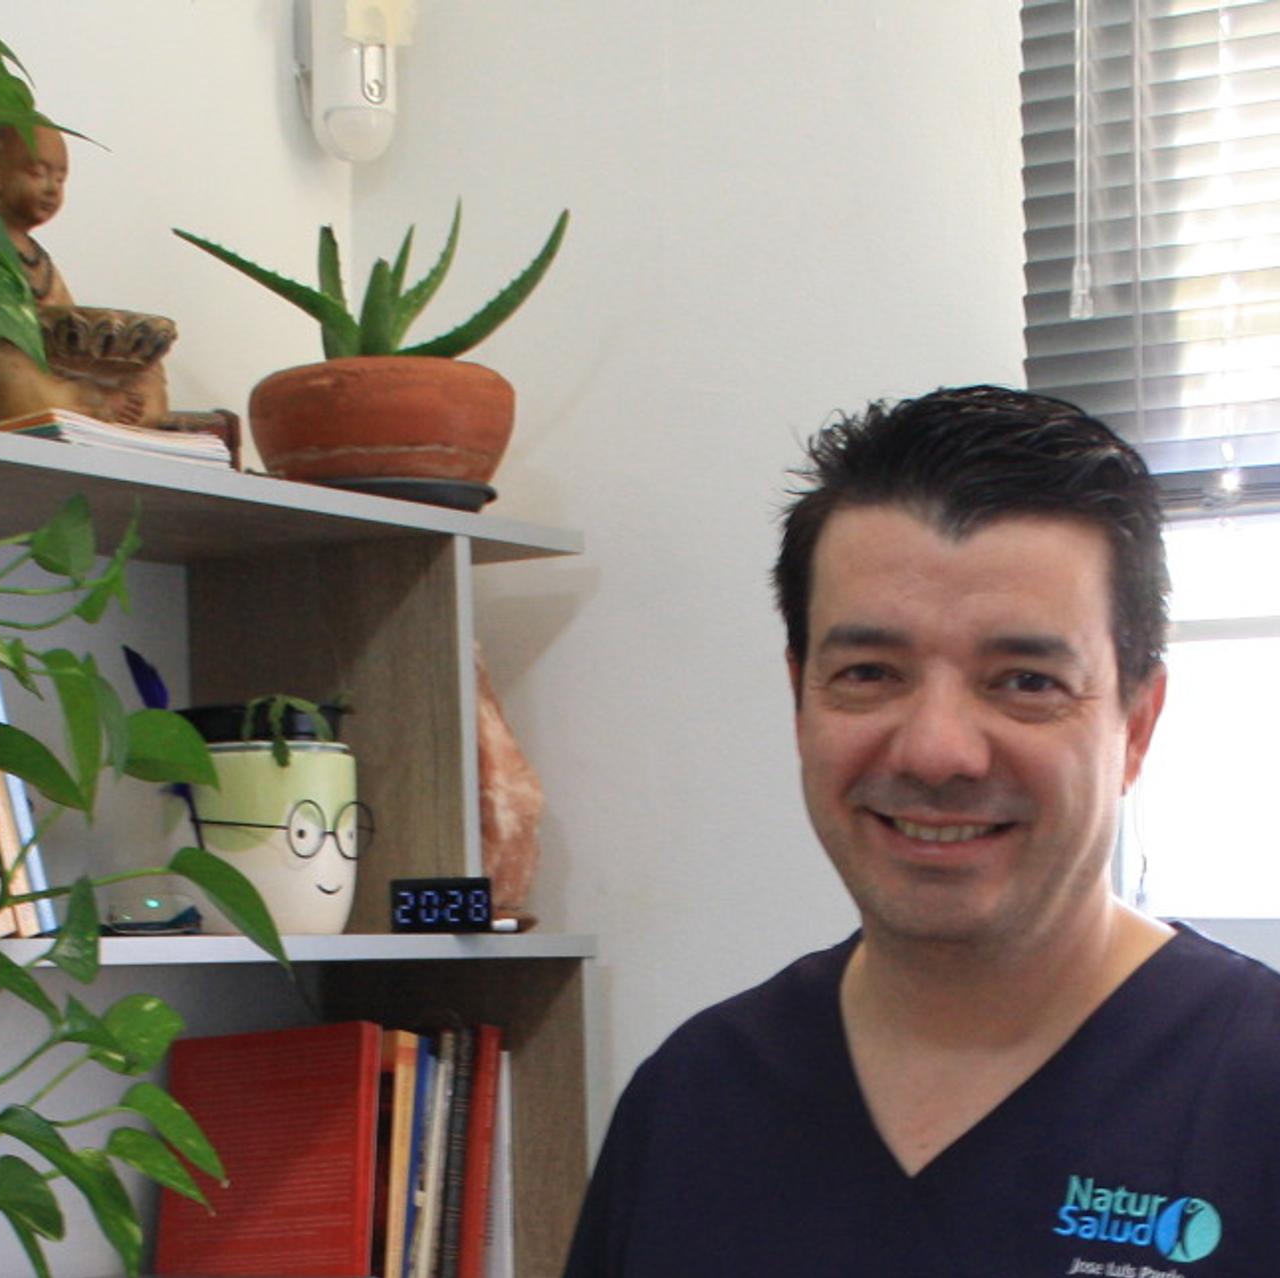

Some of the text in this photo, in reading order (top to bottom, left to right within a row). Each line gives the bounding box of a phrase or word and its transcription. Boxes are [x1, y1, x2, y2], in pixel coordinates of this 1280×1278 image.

[1066, 1176, 1166, 1217] Natur
[1053, 1205, 1156, 1245] Salud
[1106, 1260, 1136, 1278] Luis
